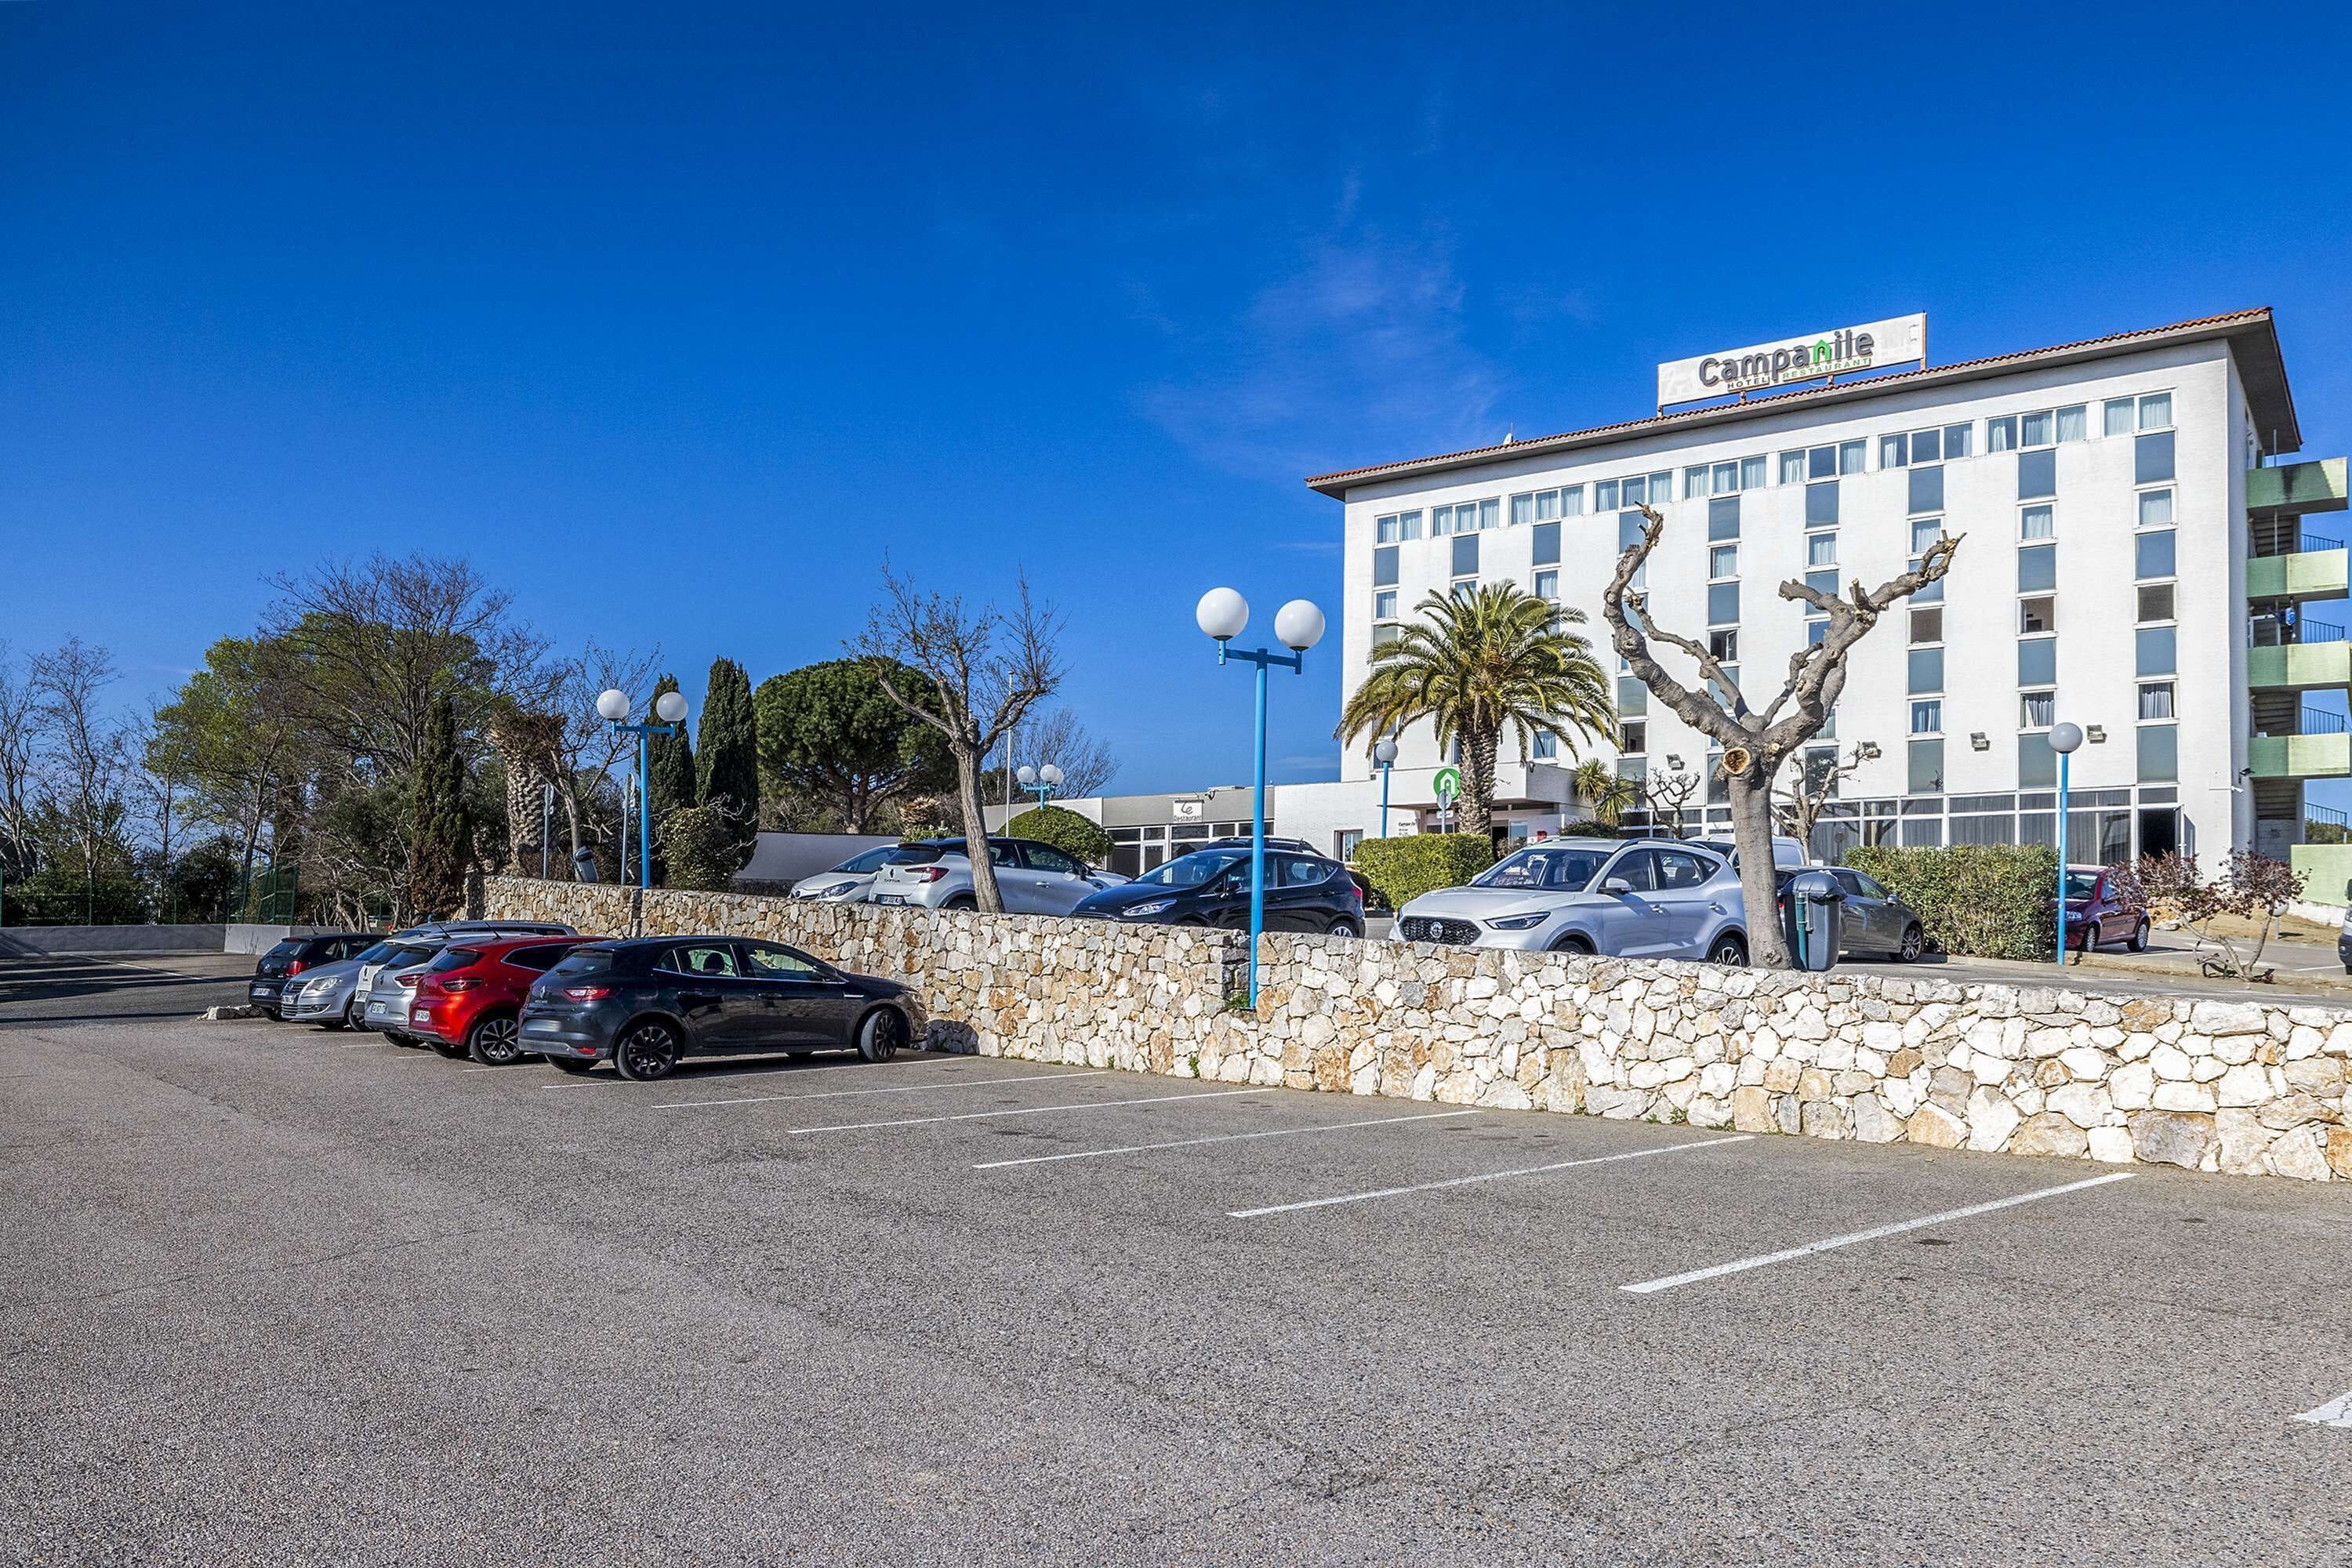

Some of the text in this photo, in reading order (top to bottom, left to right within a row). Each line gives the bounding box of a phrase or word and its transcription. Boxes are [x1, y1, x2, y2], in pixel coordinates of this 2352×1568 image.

[1699, 329, 1875, 387] Campanile
[1727, 358, 1870, 389] HOTEL RESTAURANT
